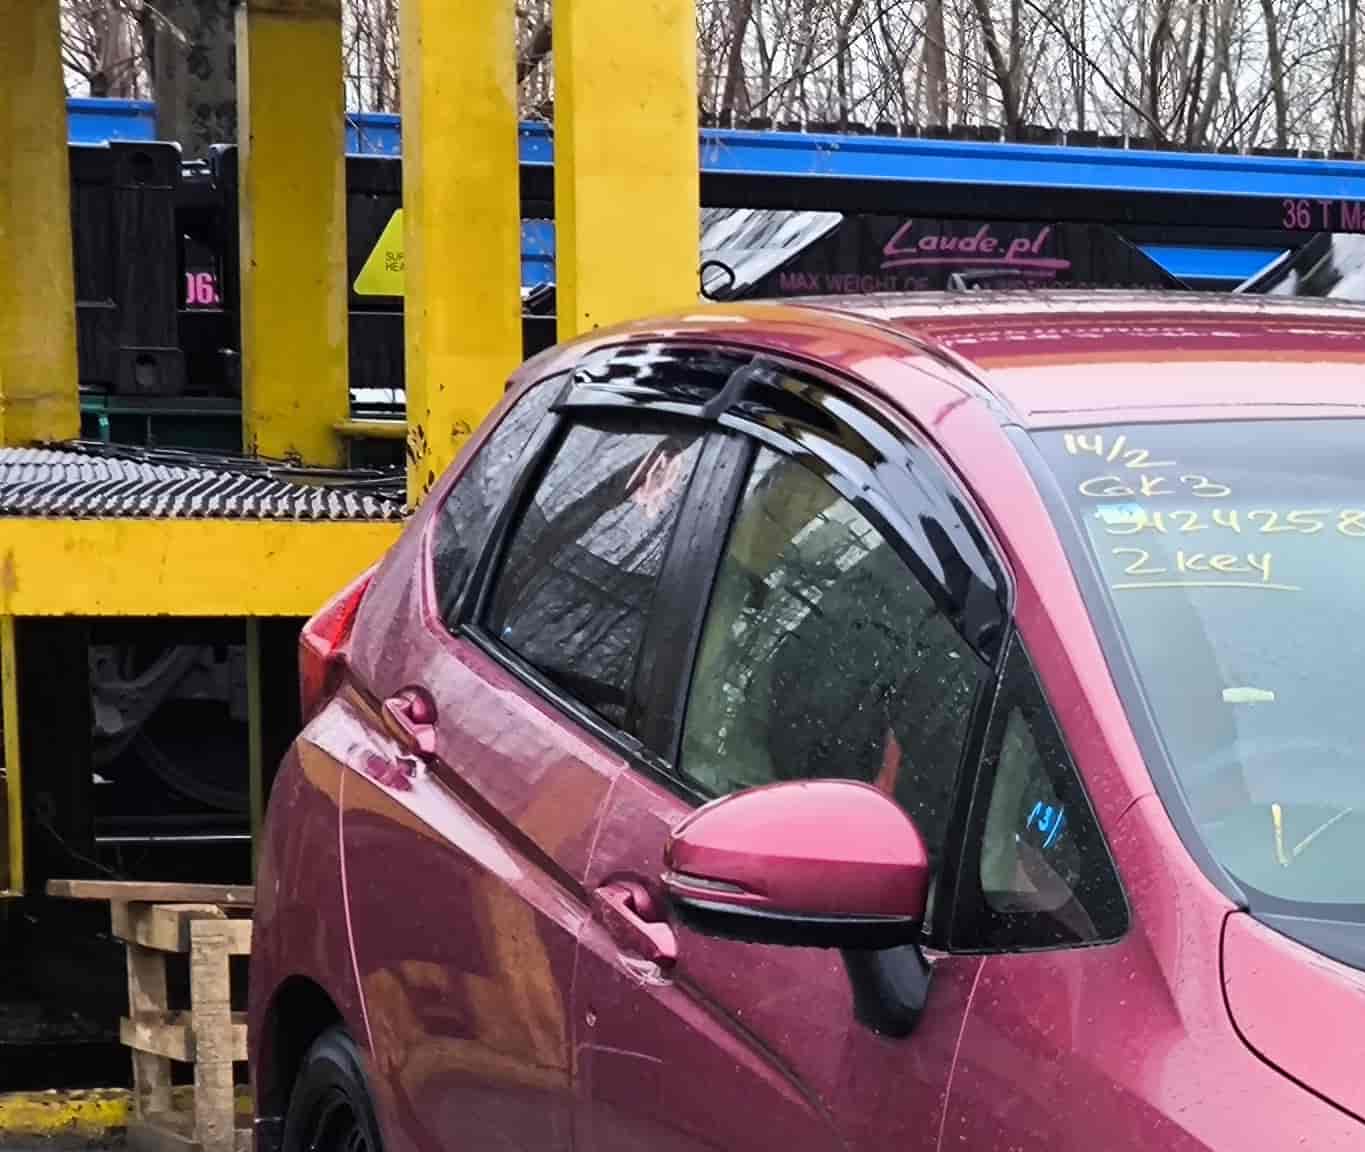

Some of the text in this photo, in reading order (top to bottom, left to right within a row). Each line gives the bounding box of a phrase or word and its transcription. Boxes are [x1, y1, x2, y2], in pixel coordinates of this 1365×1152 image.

[1282, 199, 1311, 229] 36
[1317, 200, 1332, 229] T
[883, 219, 1052, 260] Laude.pl
[779, 272, 818, 291] MAX
[826, 273, 897, 292] WEIGHT
[1111, 548, 1166, 574] 2
